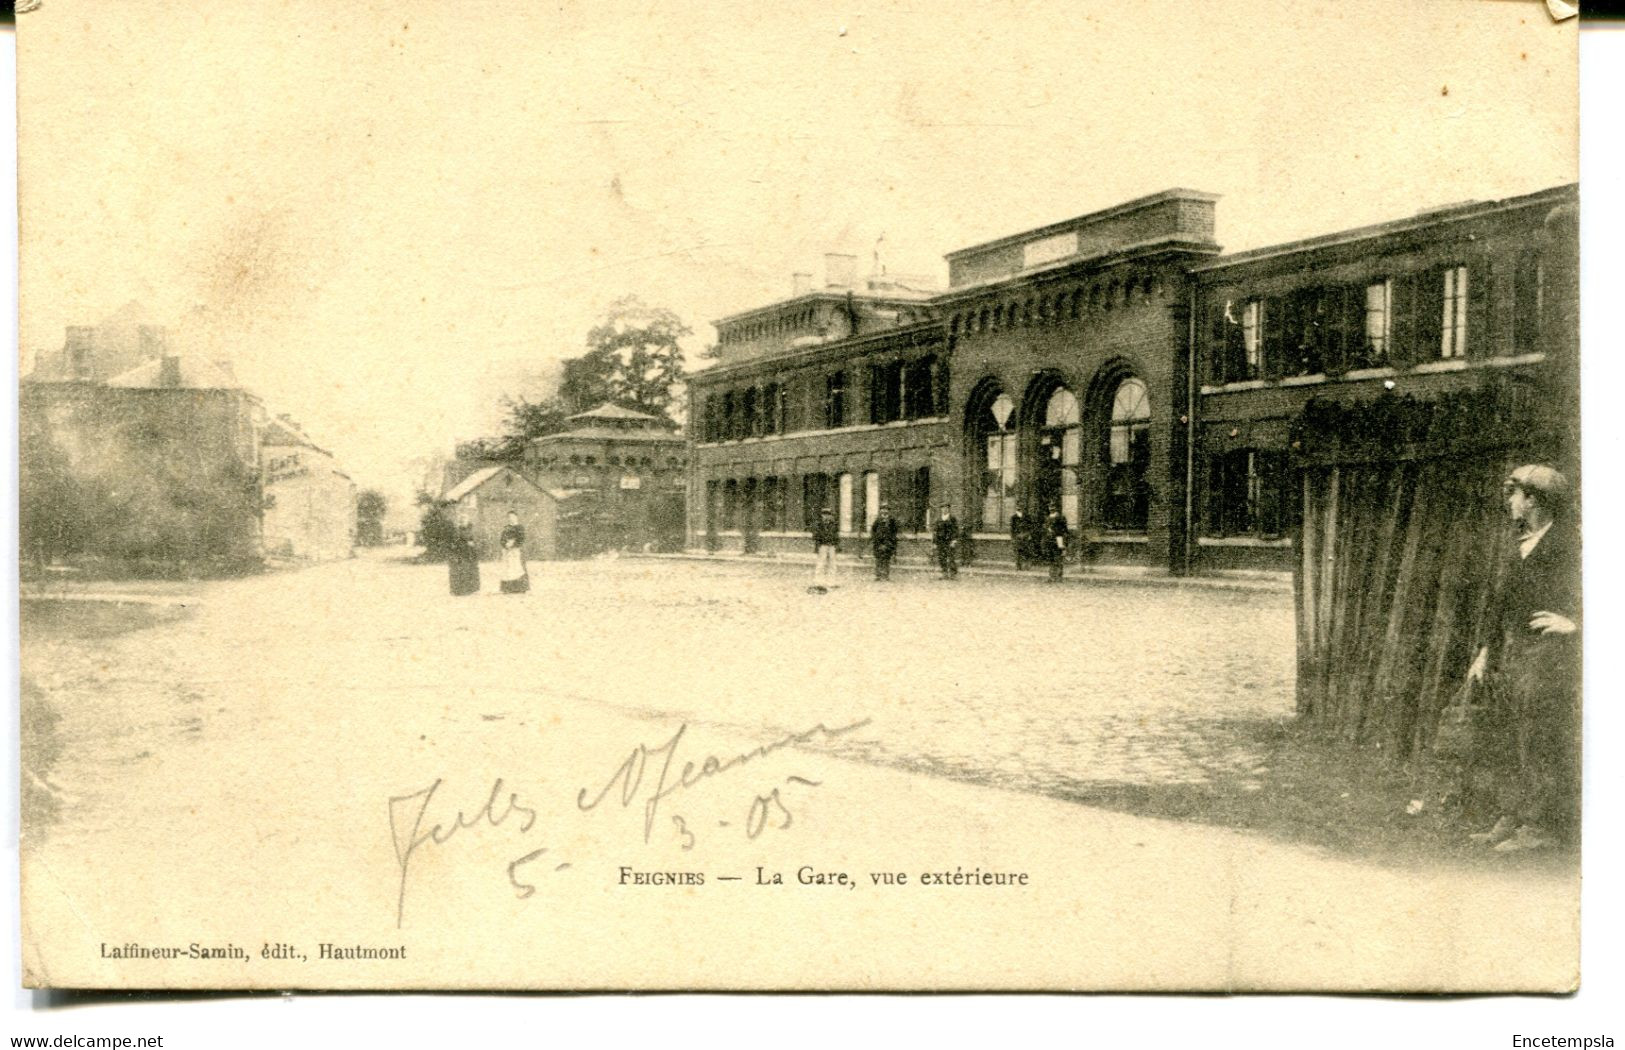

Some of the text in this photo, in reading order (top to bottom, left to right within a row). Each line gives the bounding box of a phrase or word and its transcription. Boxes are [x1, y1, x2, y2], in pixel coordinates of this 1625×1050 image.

[618, 866, 705, 886] FEIGNIES
[756, 866, 784, 885] La
[797, 866, 856, 890] Gare,
[870, 872, 907, 886] vue
[920, 865, 1029, 886] extérieure
[101, 942, 406, 963] Laffineur-Samin, édit., Hautmont
